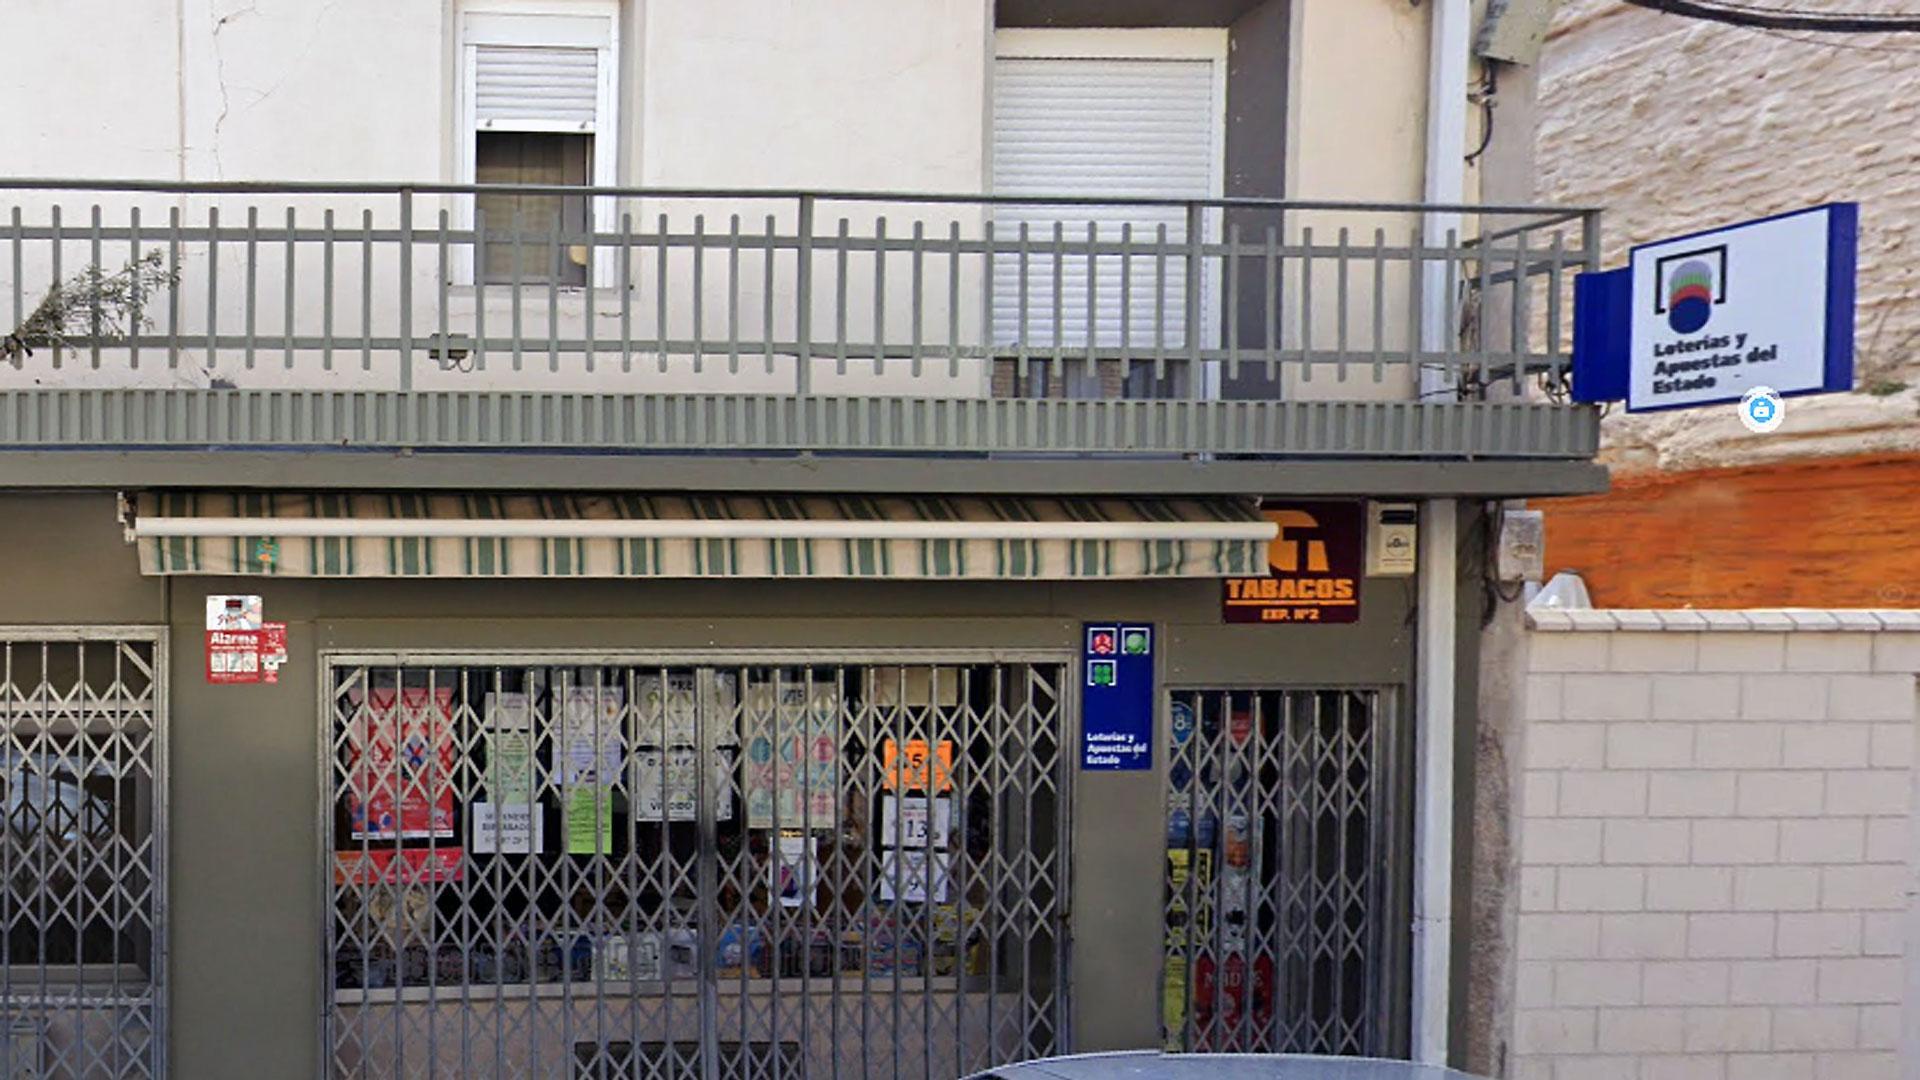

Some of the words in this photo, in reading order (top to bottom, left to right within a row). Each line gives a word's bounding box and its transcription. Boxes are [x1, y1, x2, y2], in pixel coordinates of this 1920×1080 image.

[1653, 334, 1730, 357] Loterías
[1735, 333, 1747, 349] y
[1653, 354, 1741, 377] Apuestas
[1746, 344, 1777, 363] del
[1652, 374, 1716, 394] Estado
[1226, 578, 1353, 599] TABACOS
[210, 631, 259, 645] Alarma
[1087, 743, 1132, 755] Apuestas
[1133, 743, 1147, 753] del
[1086, 754, 1120, 765] Estado
